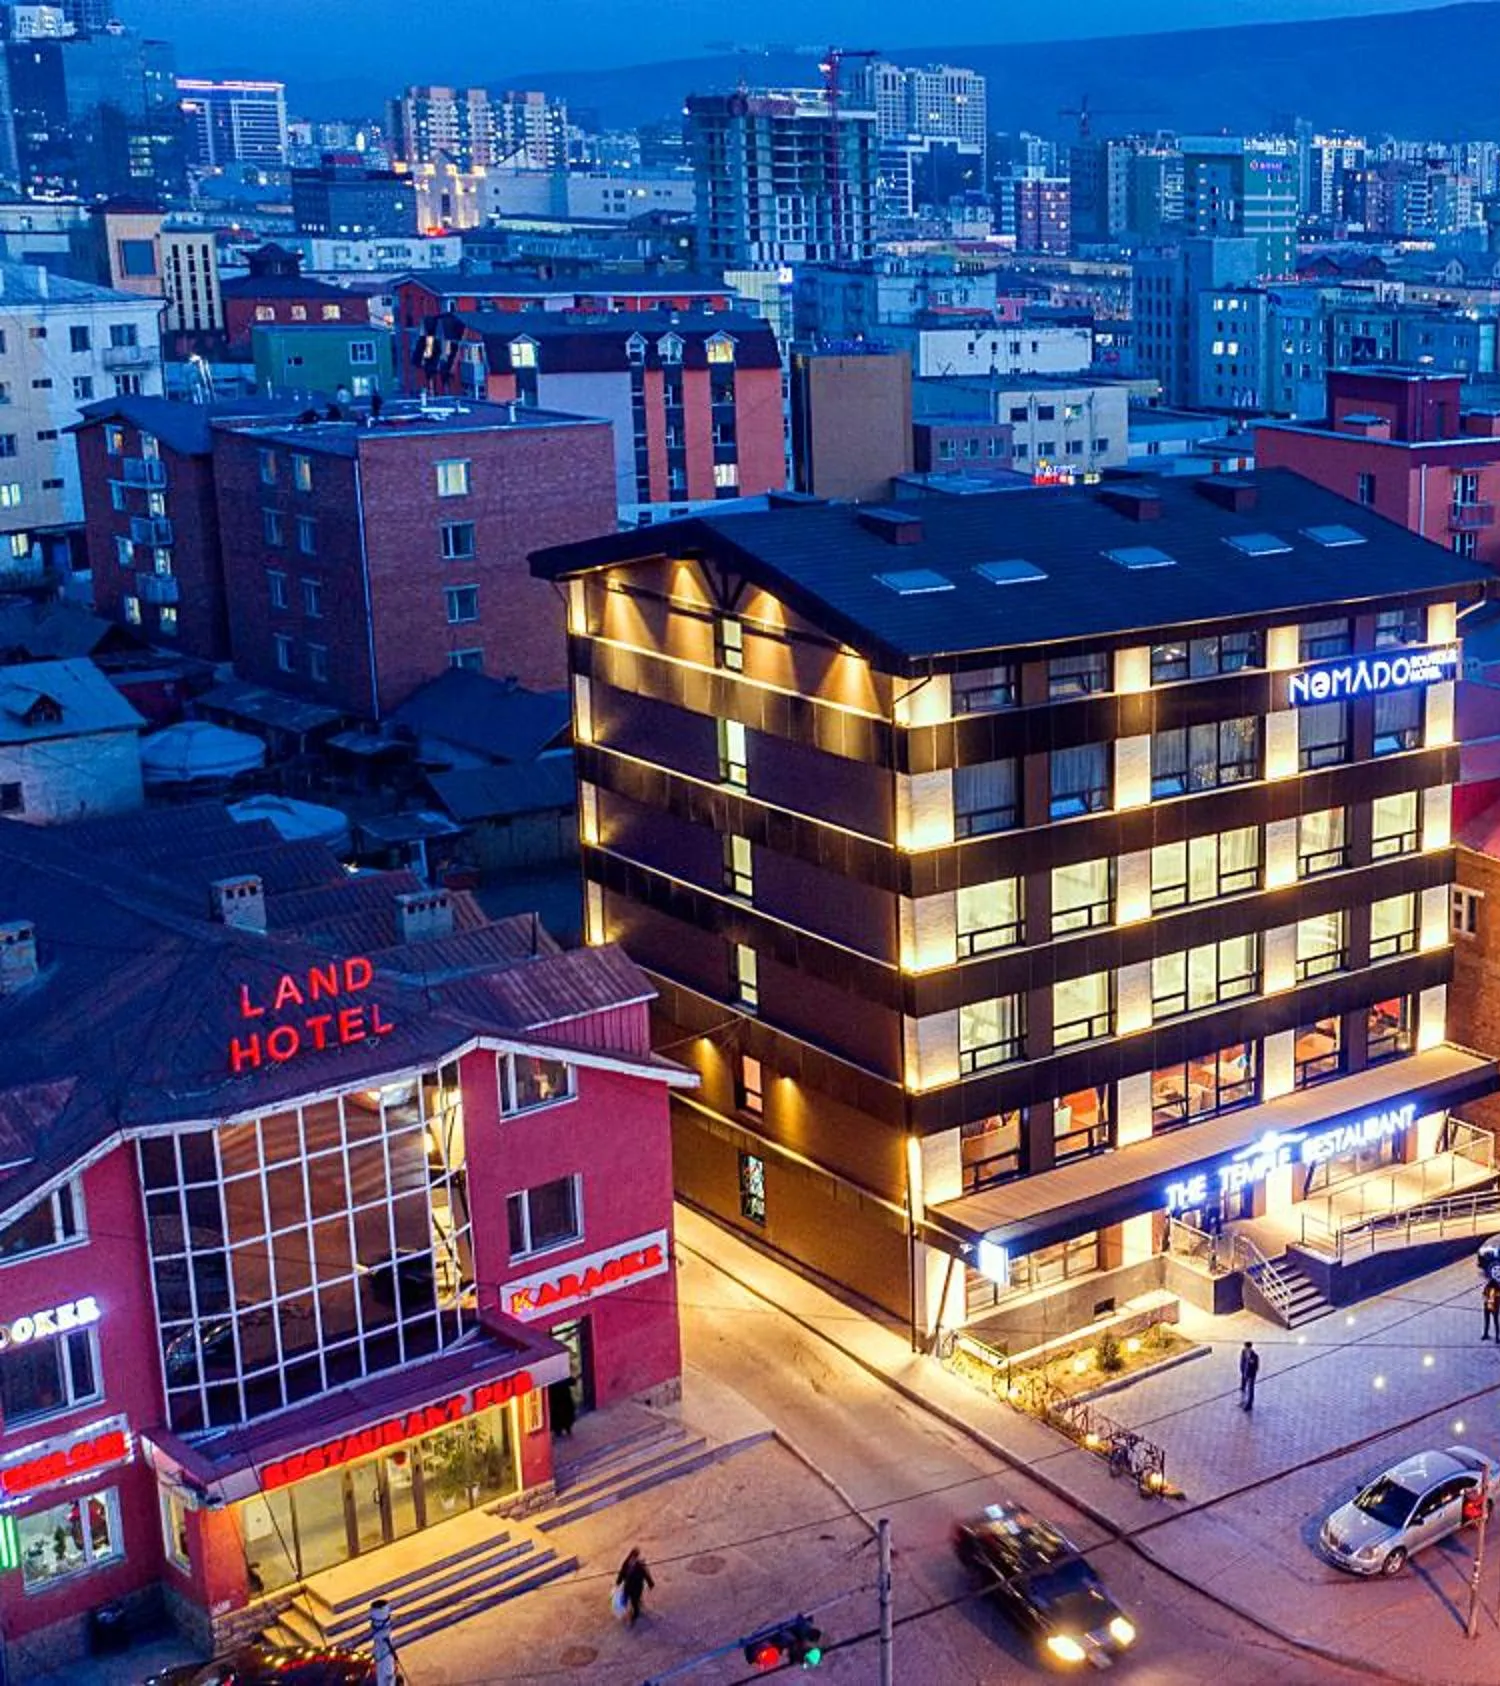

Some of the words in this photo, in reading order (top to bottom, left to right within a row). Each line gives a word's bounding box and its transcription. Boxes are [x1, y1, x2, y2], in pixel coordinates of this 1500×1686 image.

[1289, 657, 1409, 704] NOMADO
[241, 956, 373, 1018] LAND
[230, 1003, 394, 1073] HOTEL
[1166, 1176, 1207, 1209] THE
[1220, 1147, 1291, 1194] TEMPLE
[1301, 1104, 1417, 1164] RESTAURANT
[511, 1244, 663, 1313] KARAOKE
[260, 1395, 466, 1492] RESTAURANT
[472, 1371, 532, 1412] PUB
